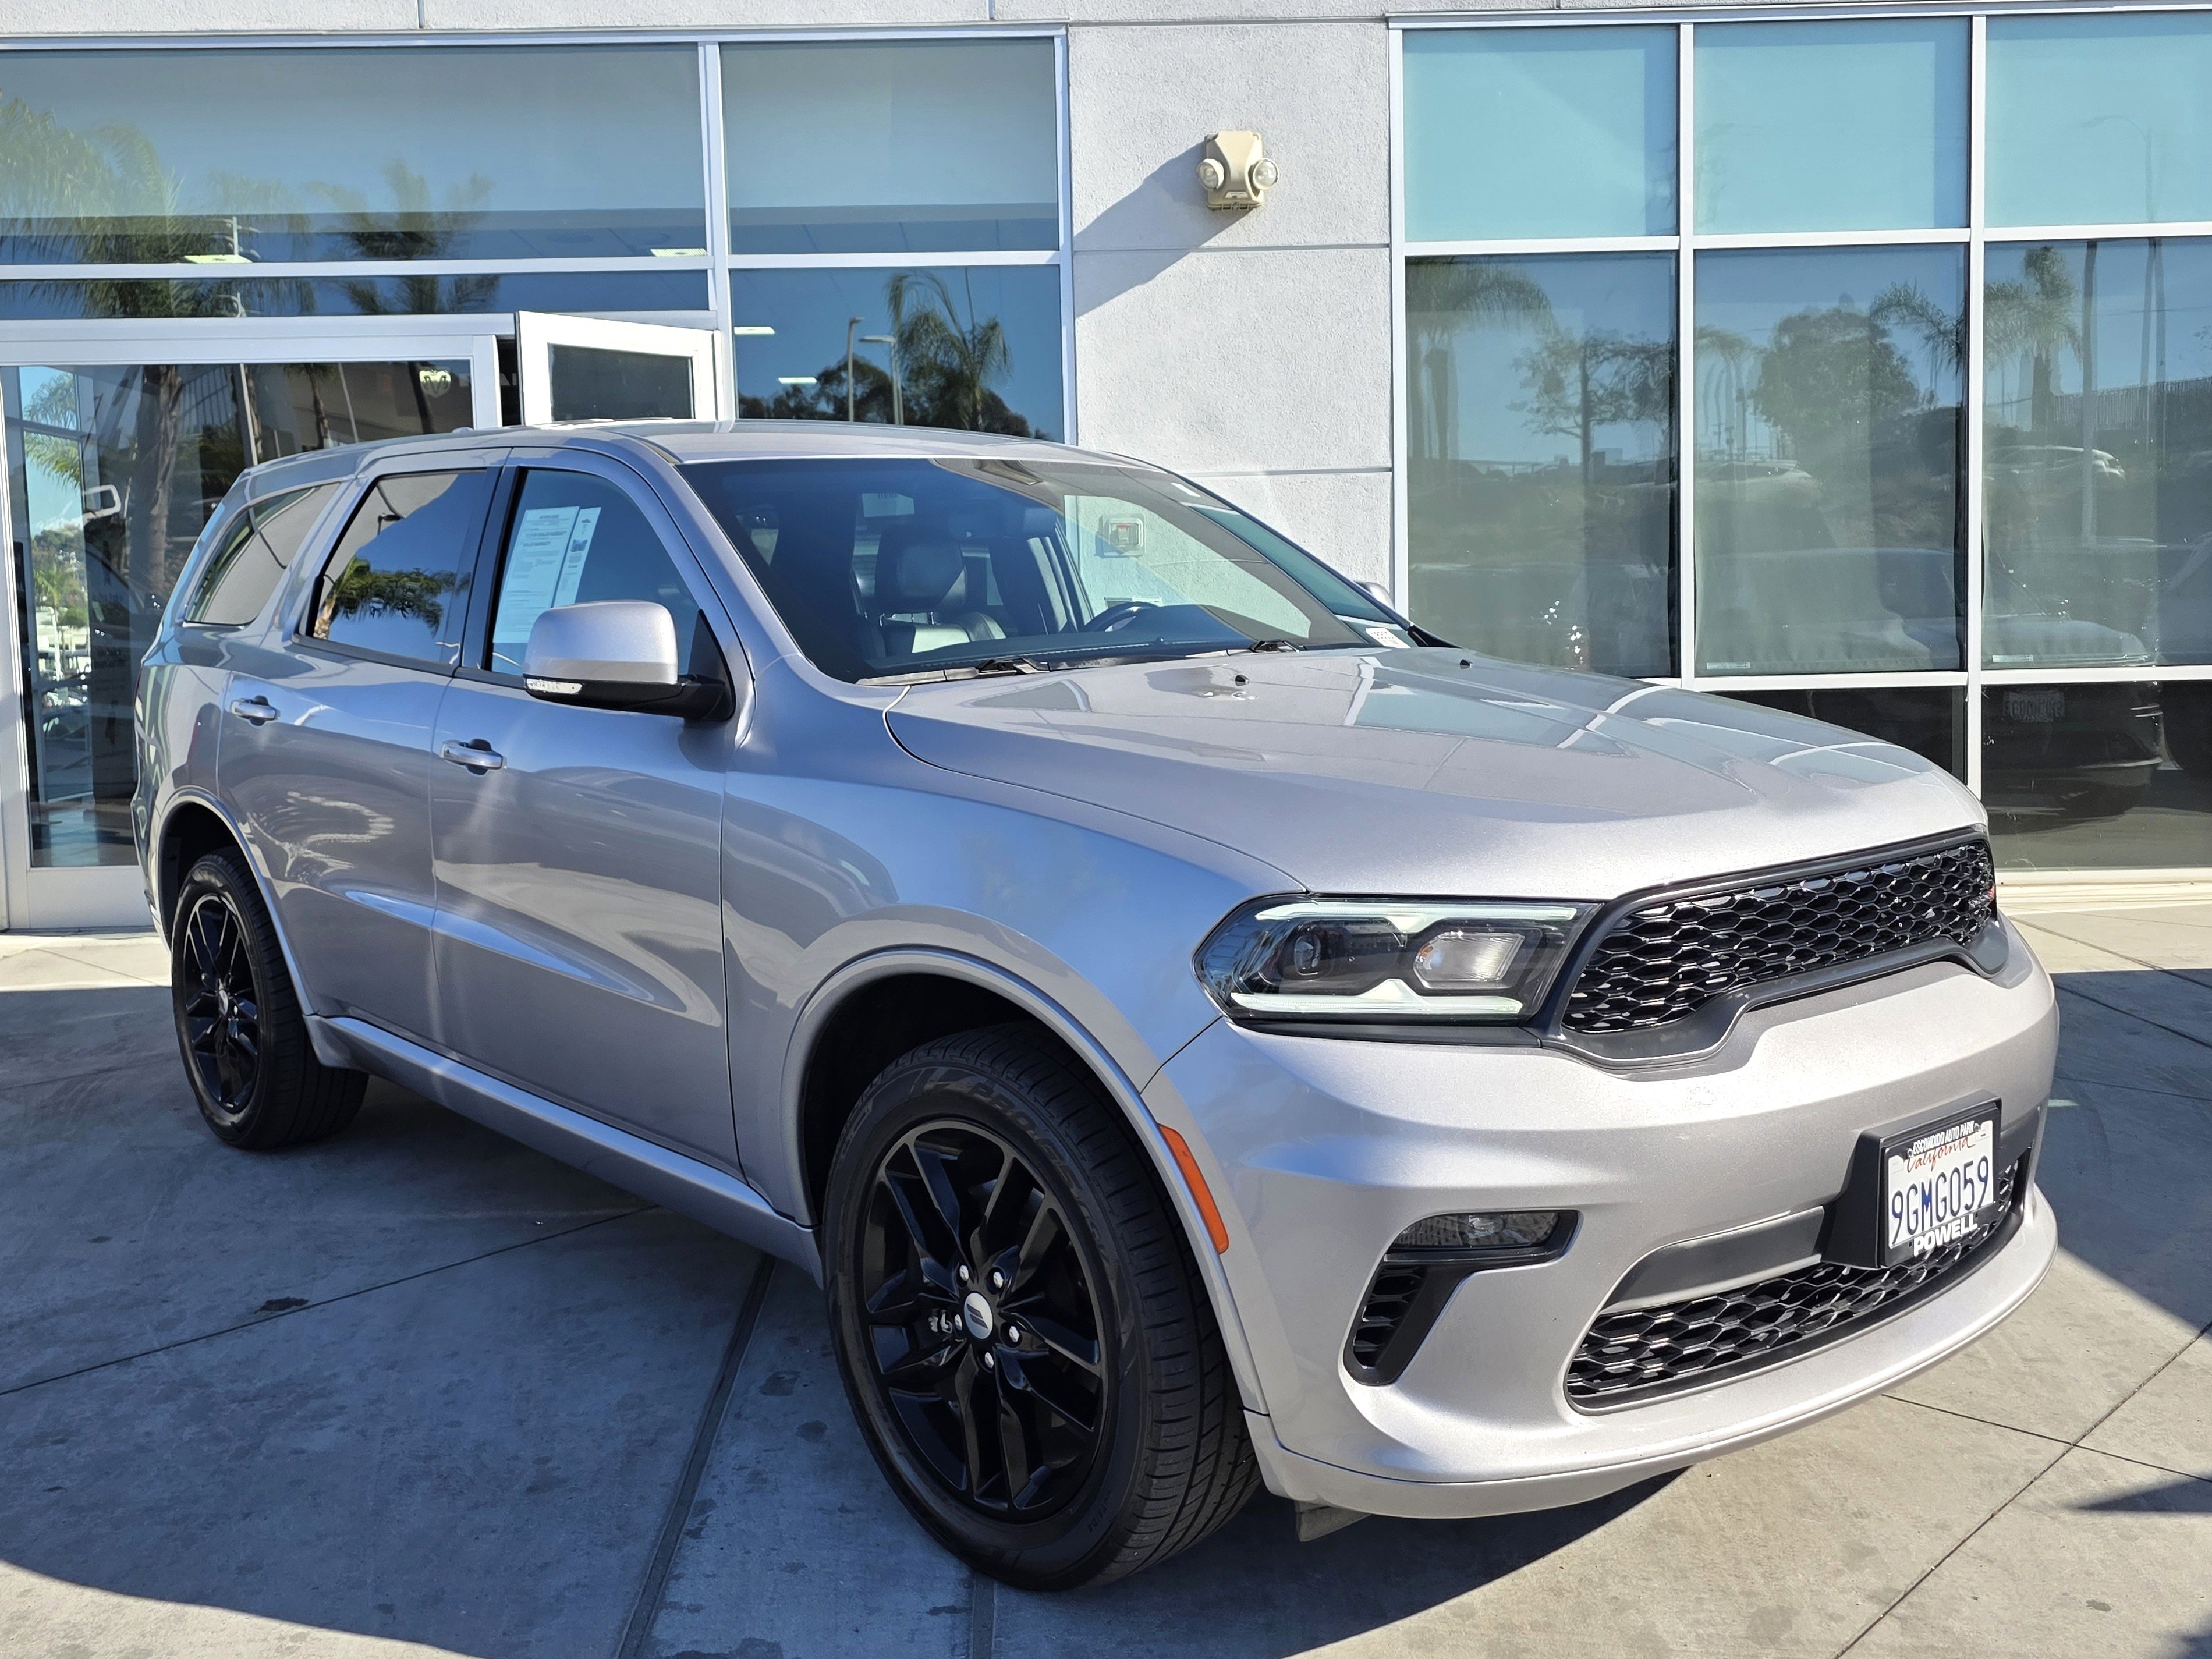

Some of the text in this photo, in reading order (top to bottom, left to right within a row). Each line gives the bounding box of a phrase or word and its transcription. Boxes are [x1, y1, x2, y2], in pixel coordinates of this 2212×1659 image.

[1907, 1136, 1976, 1173] California
[1913, 1120, 1975, 1155] ESCONDIDO AUTO PARK
[1892, 1155, 1989, 1245] 9GMG059
[1913, 1213, 1978, 1257] POWELL
